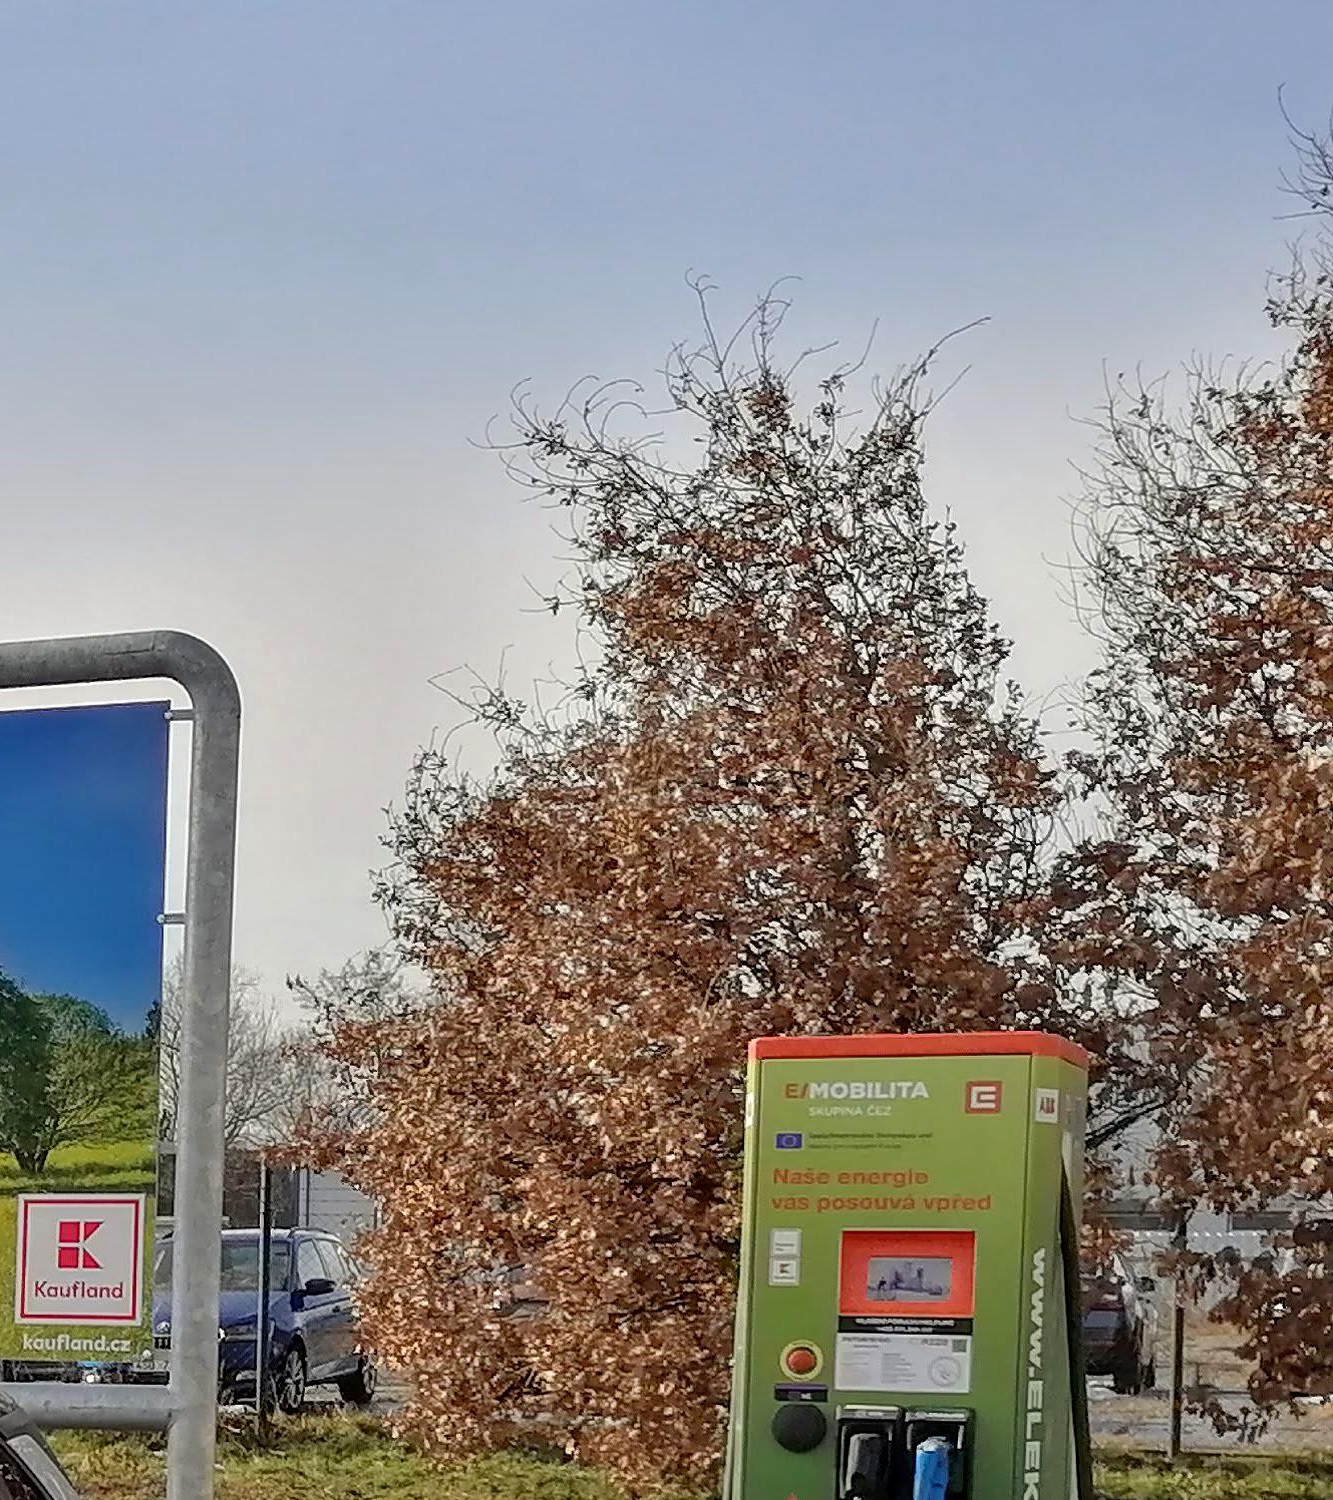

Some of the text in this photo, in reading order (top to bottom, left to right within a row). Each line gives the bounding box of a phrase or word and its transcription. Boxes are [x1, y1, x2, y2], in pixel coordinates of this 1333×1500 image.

[808, 1104, 893, 1117] SKUPINA ČEZ
[772, 1167, 930, 1188] Naše energie
[771, 1193, 992, 1213] vás posouvá vpřed
[33, 1280, 124, 1299] Kaufland
[22, 1334, 132, 1352] kaufland.cz
